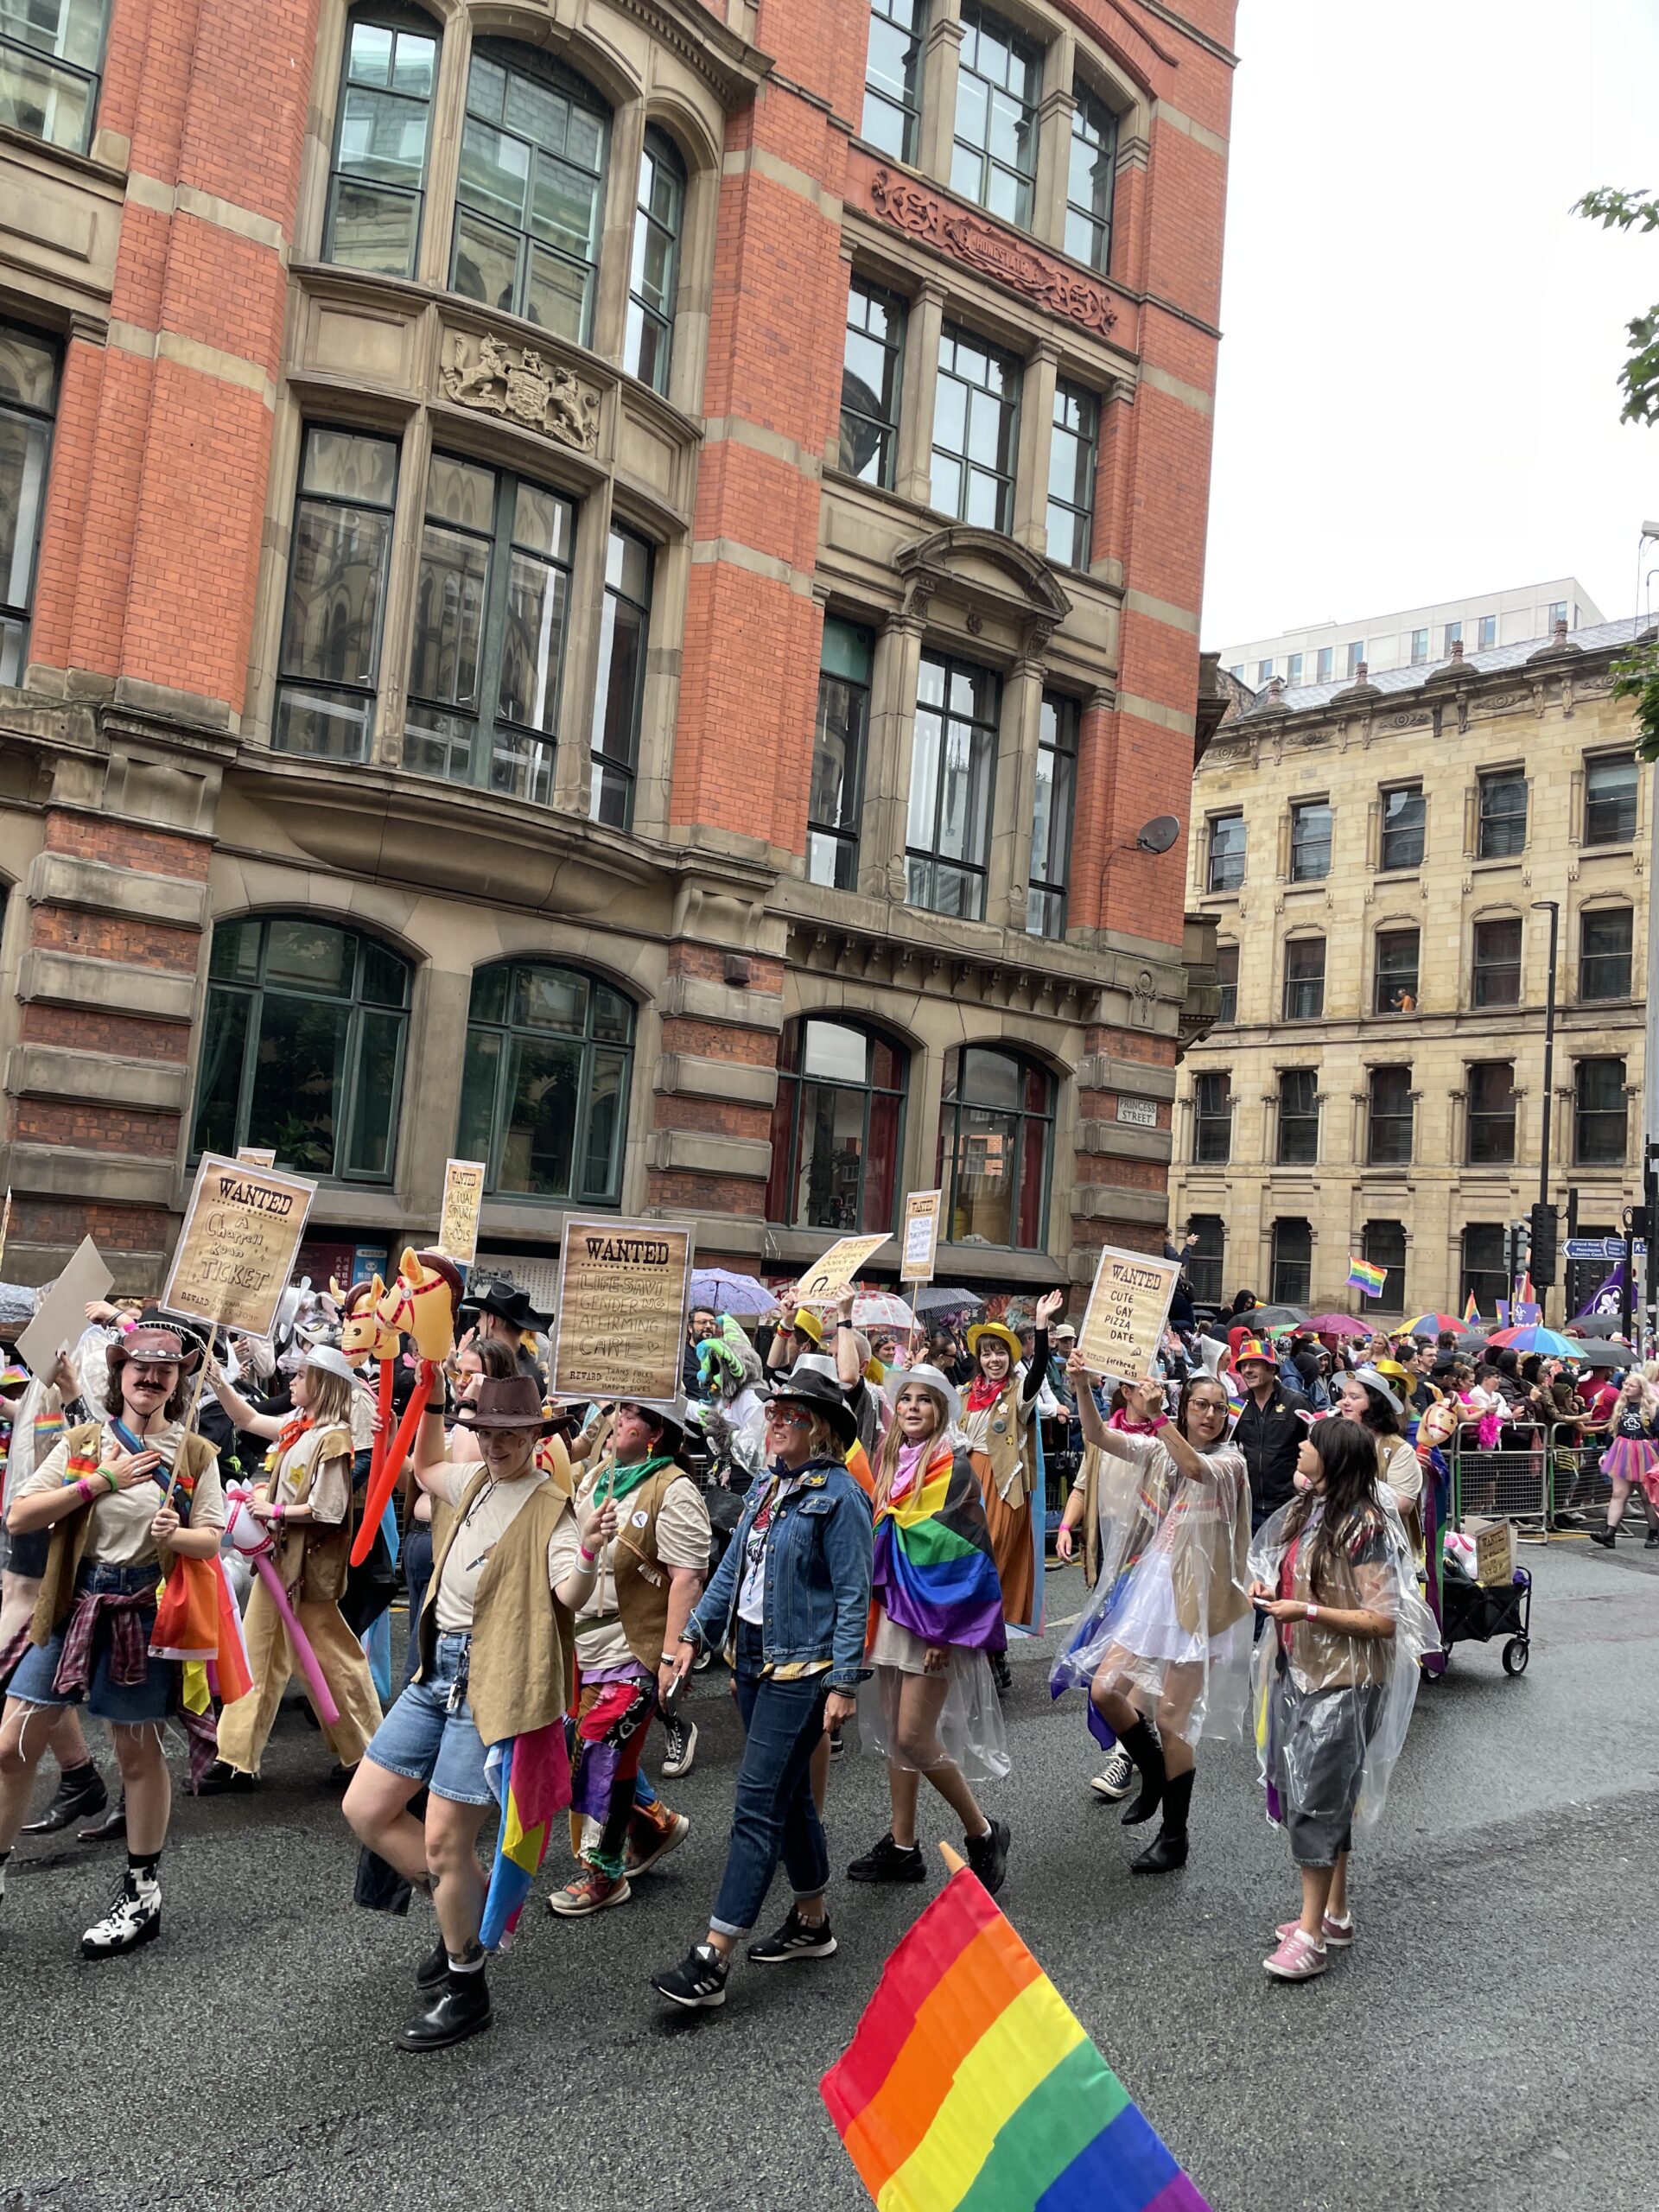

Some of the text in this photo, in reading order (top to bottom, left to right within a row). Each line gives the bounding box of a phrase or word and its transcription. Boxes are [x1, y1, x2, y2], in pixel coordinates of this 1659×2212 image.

[1120, 1098, 1156, 1114] PRINCESS
[1122, 1109, 1153, 1123] STREET
[219, 1177, 294, 1216] WANTED
[448, 1192, 474, 1205] ACTUAL
[206, 1211, 264, 1245] Chappell
[234, 1217, 249, 1230] A
[211, 1239, 245, 1258] Roan
[585, 1237, 670, 1265] WANTED
[201, 1257, 270, 1292] TICKET
[1113, 1264, 1162, 1291] WANTED
[580, 1294, 638, 1313] GENDER
[642, 1297, 665, 1310] NG
[1110, 1290, 1135, 1304] CUTE
[1116, 1305, 1134, 1319] GAY
[579, 1313, 659, 1332] AFFIRMING
[1104, 1314, 1131, 1331] PIZZA
[1110, 1331, 1135, 1344] DATE
[579, 1333, 644, 1359] CARE
[1106, 1357, 1136, 1370] forehead
[607, 1367, 654, 1378] TRANS FOLKS
